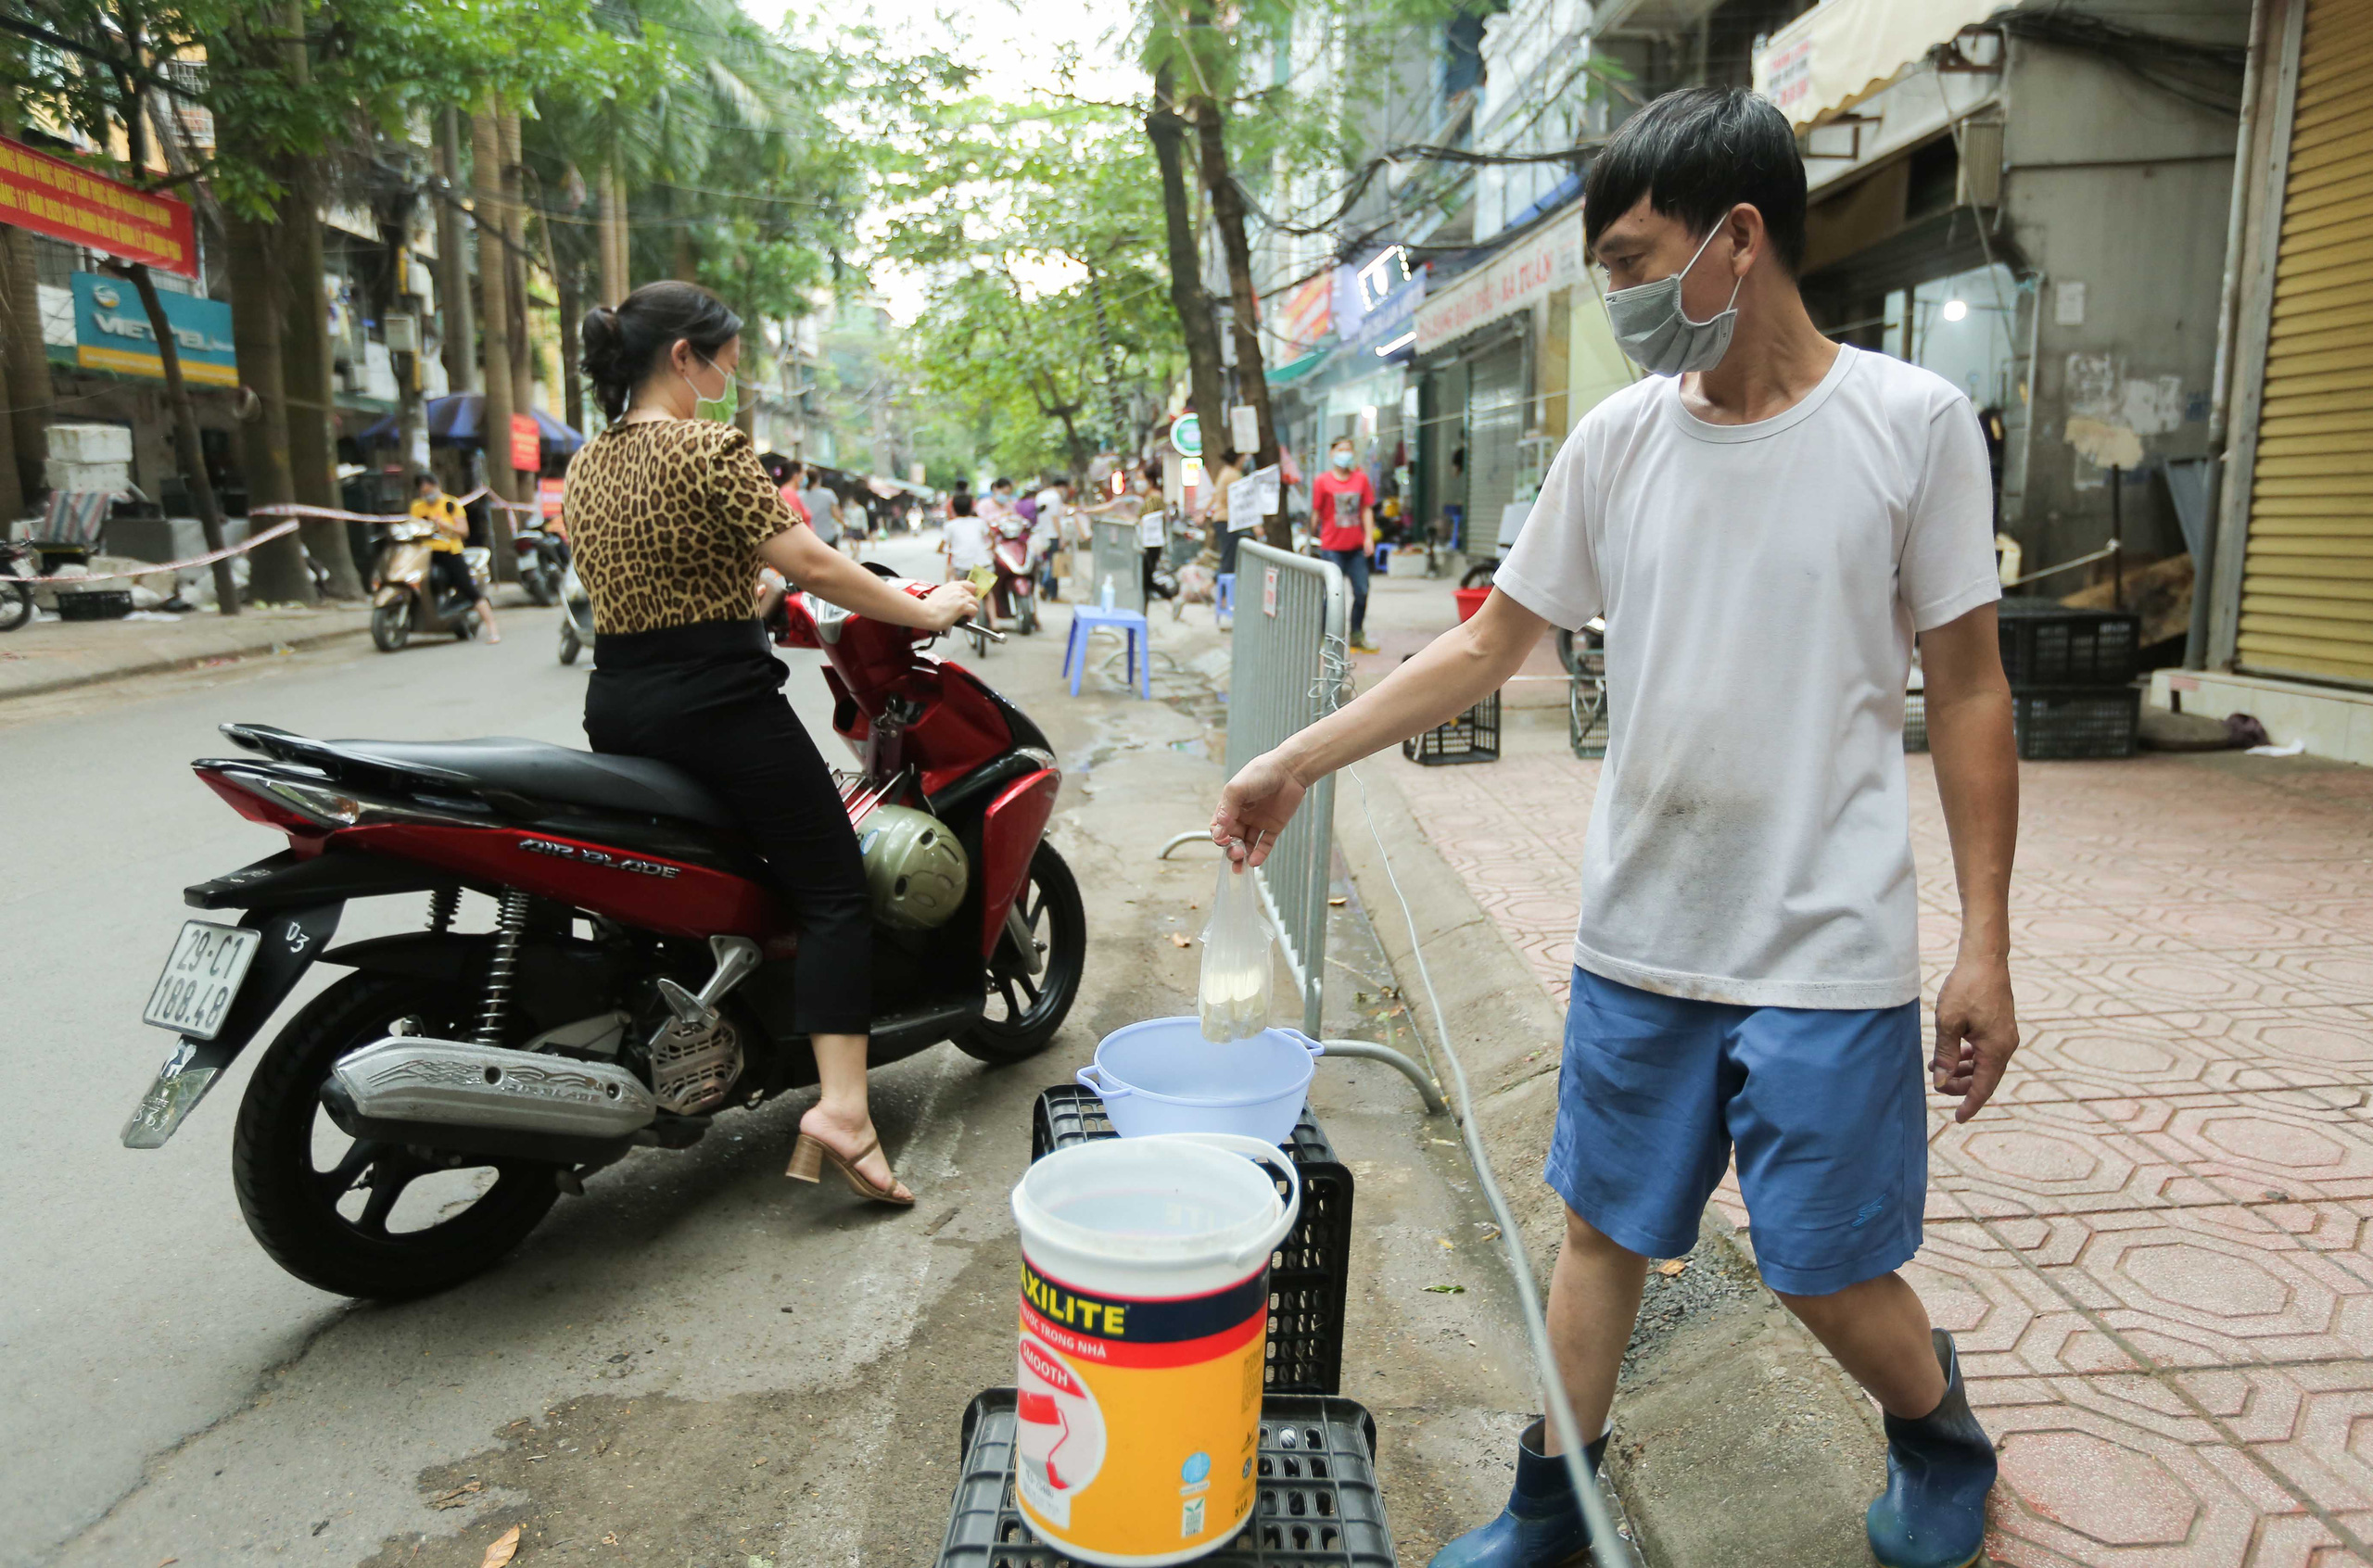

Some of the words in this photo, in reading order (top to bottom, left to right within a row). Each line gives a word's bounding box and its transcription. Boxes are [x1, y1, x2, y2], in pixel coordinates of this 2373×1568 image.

[518, 838, 575, 859] AIR
[581, 848, 681, 879] BLADE
[153, 975, 230, 1029] 188.48
[1022, 1260, 1125, 1336] AXILITE
[1041, 1321, 1075, 1348] TRONG
[1078, 1340, 1107, 1359] NHÀ
[1022, 1342, 1069, 1387] SMOOTH
